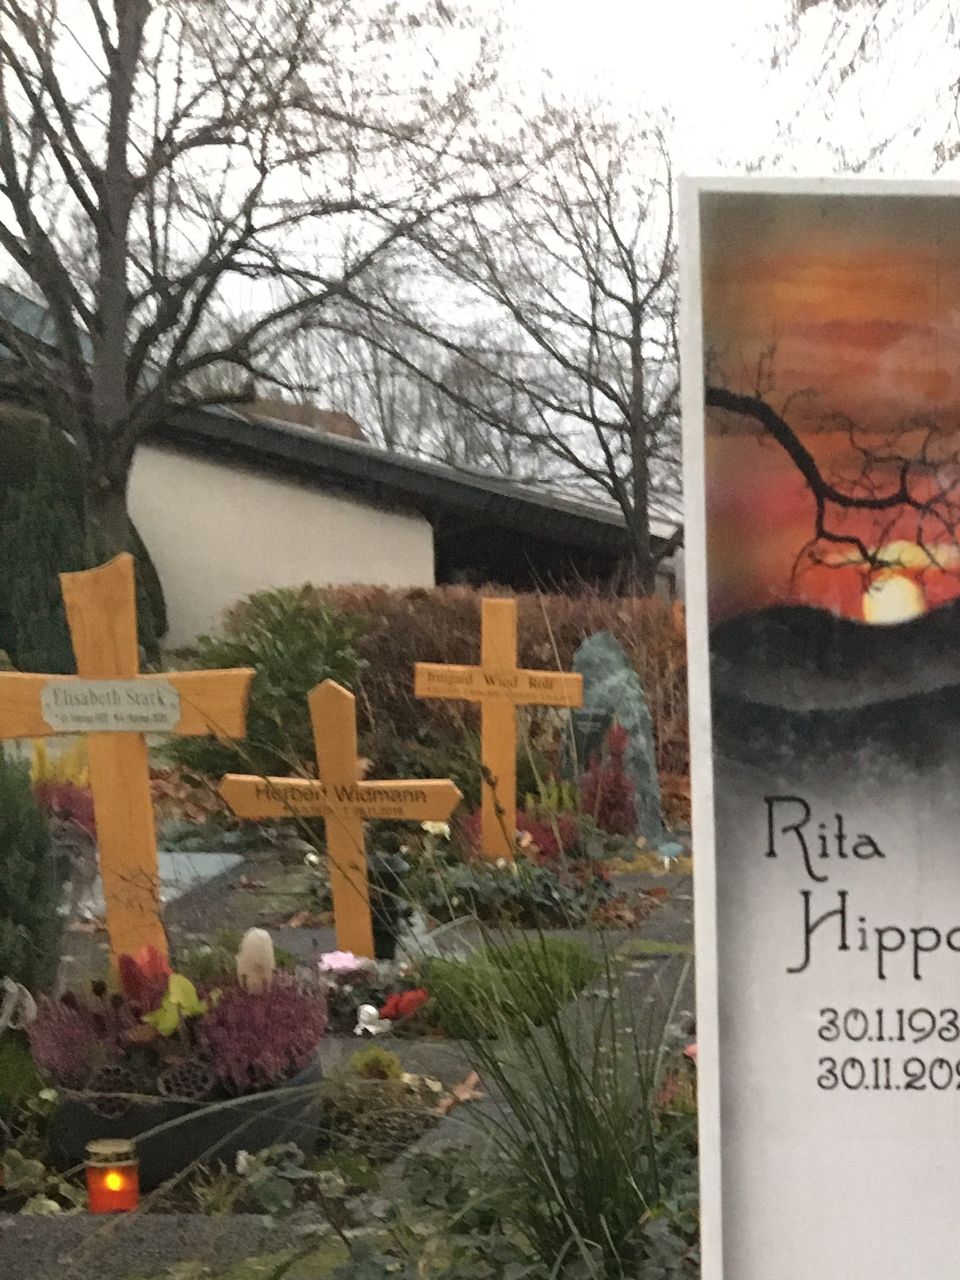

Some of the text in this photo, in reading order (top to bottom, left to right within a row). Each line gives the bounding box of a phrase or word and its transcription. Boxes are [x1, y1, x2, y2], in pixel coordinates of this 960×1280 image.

[52, 687, 166, 707] Elisabeth Stark
[255, 784, 327, 800] Herbert
[764, 795, 886, 882] Rita
